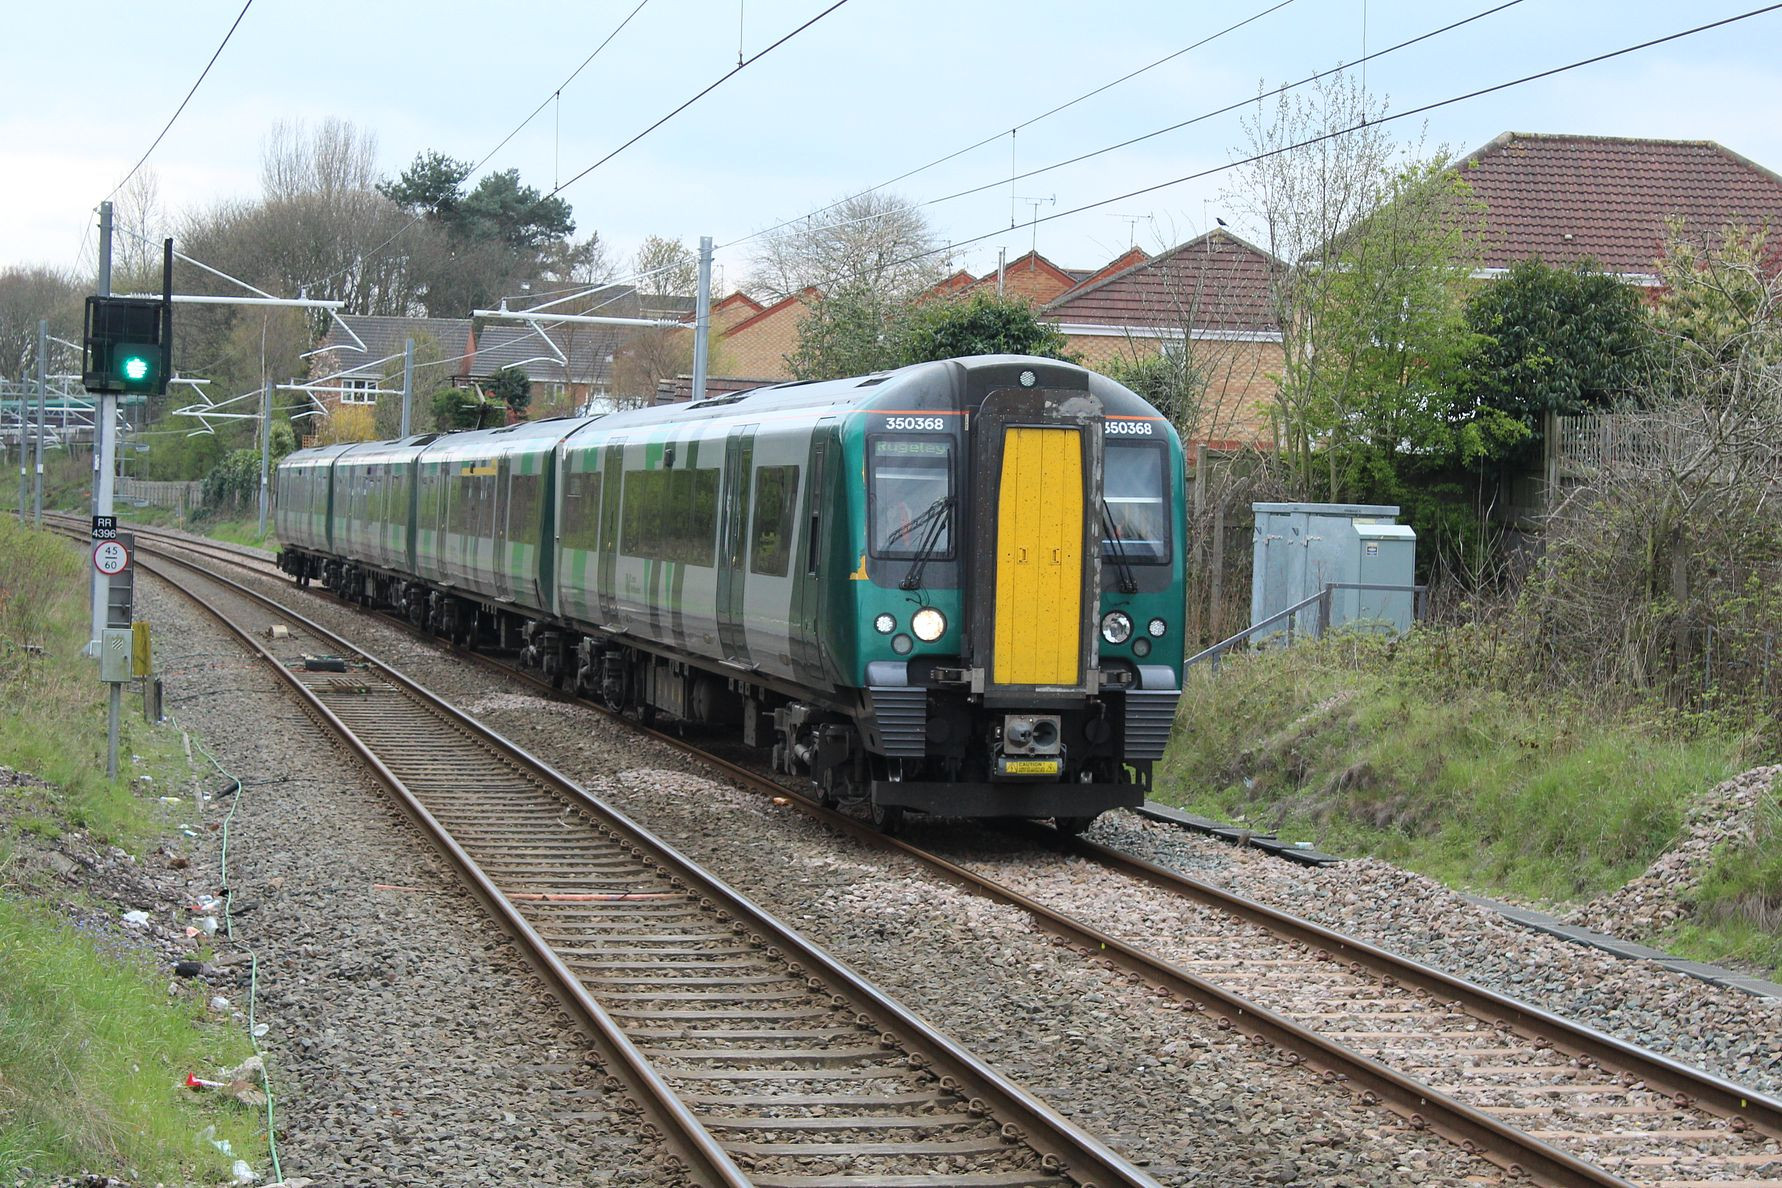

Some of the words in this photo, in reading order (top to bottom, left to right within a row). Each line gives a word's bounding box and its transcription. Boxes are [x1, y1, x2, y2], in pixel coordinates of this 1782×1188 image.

[886, 417, 944, 430] 350368
[877, 441, 946, 455] Rugeley
[98, 518, 112, 527] RR
[92, 529, 116, 538] 4396
[105, 546, 118, 555] 45
[104, 561, 117, 570] 60
